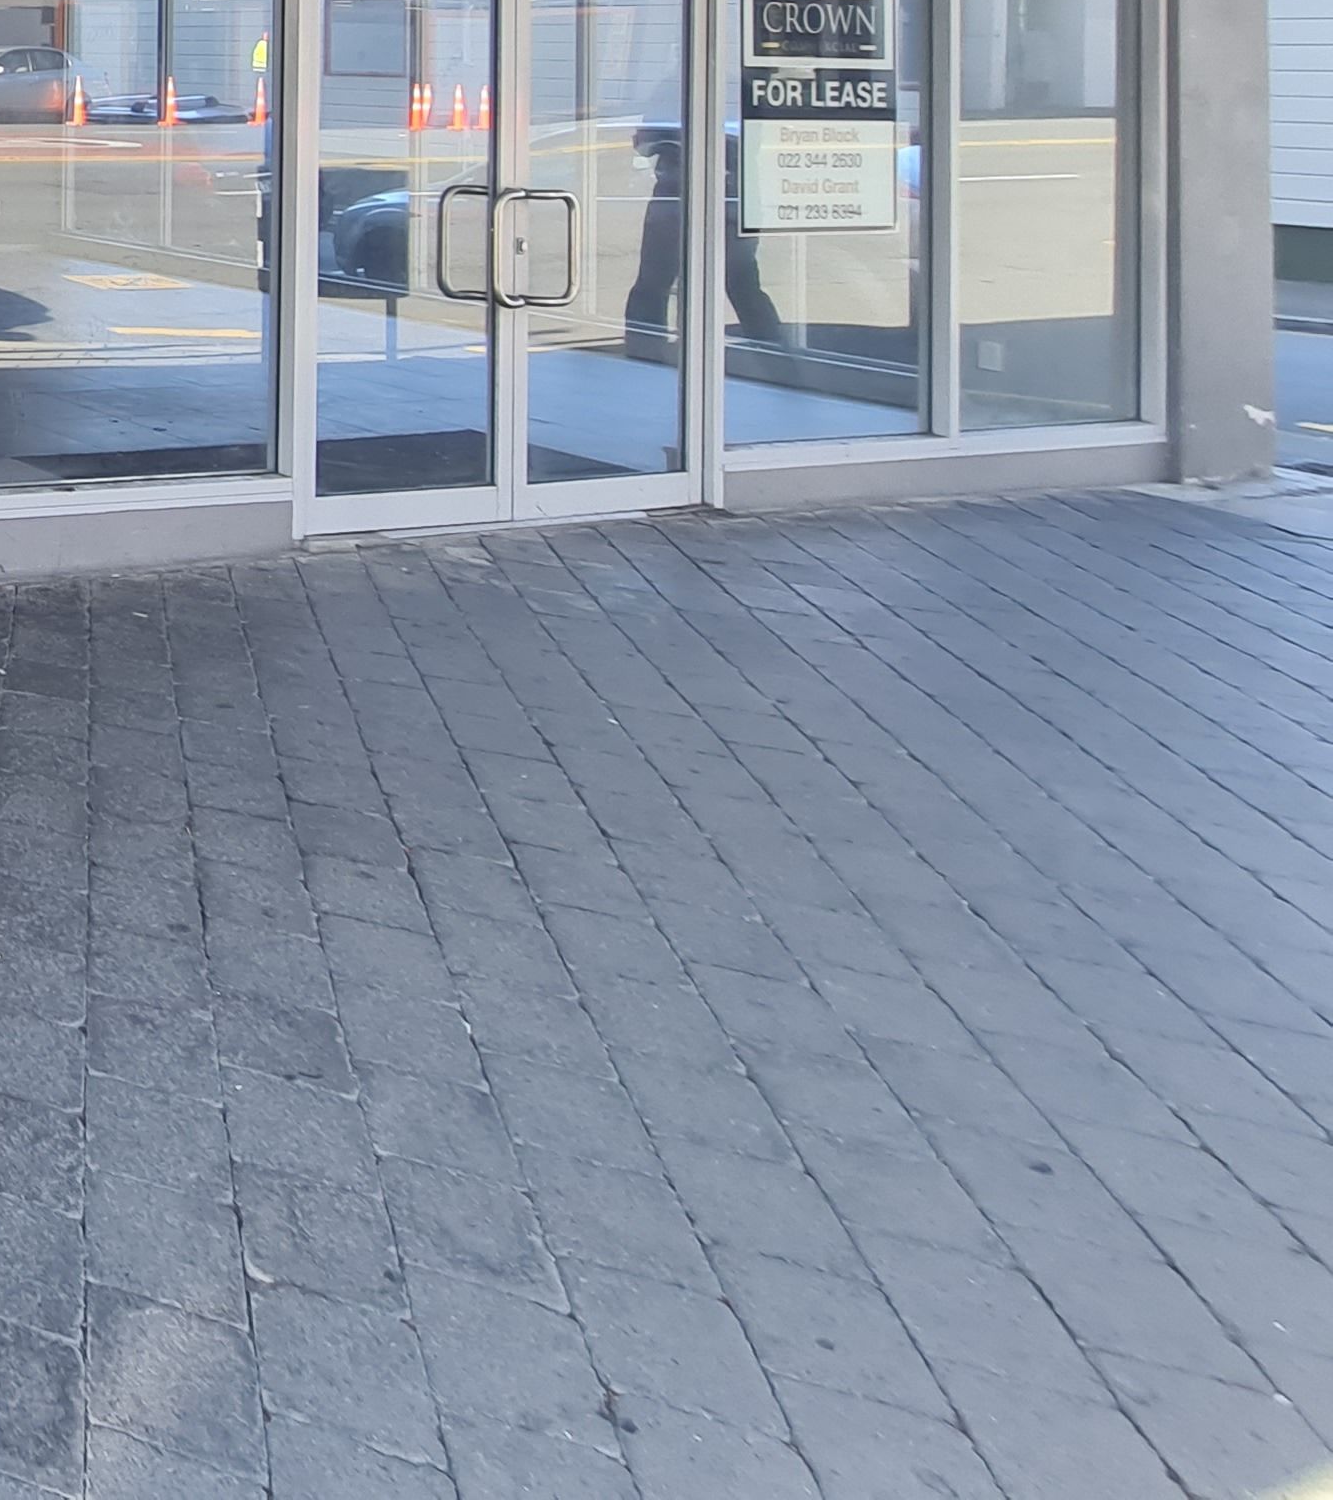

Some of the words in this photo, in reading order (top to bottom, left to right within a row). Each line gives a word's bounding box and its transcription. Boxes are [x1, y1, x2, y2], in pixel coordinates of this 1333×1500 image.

[762, 1, 876, 35] CROWN
[752, 79, 803, 107] FOR
[811, 81, 887, 109] LEASE
[780, 127, 818, 145] Bryan
[778, 153, 801, 167] 022
[805, 154, 828, 167] 344
[782, 179, 818, 194] David
[822, 179, 860, 194] Grant
[778, 205, 800, 220] 021
